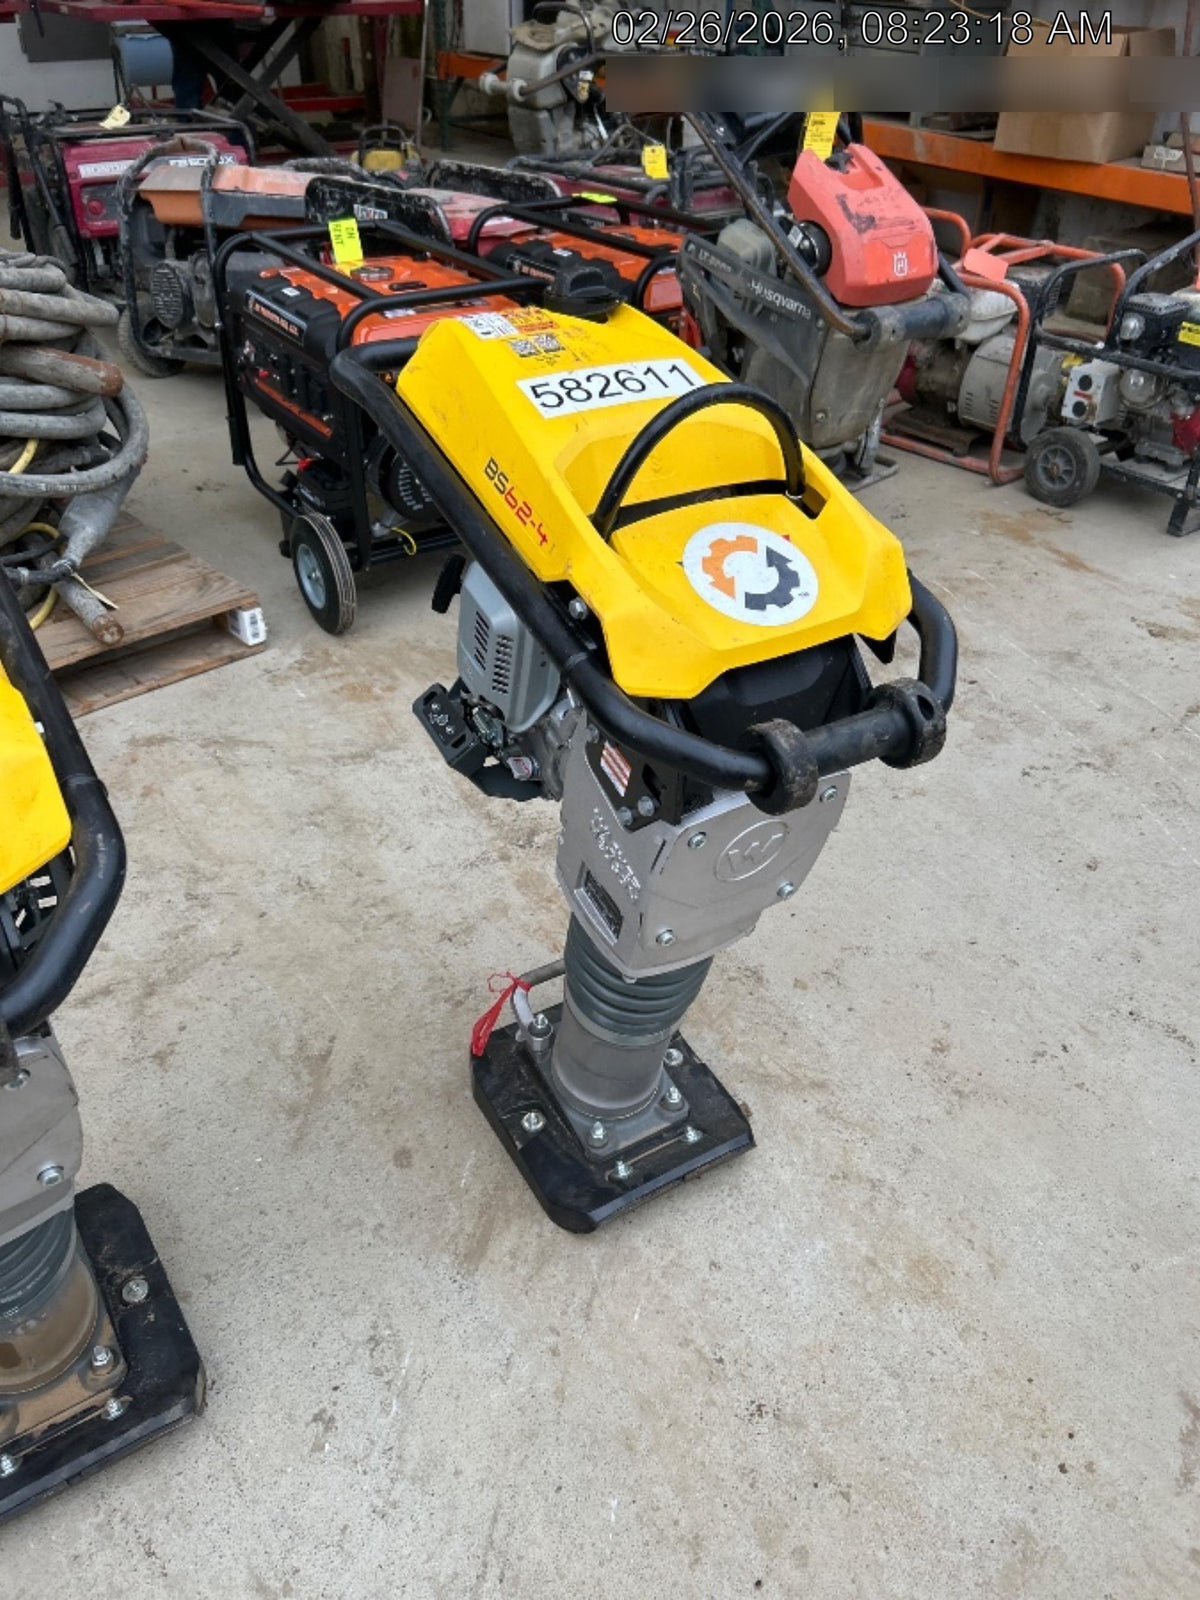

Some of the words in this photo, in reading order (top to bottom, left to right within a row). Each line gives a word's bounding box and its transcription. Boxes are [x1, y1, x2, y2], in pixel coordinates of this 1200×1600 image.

[751, 279, 812, 320] Husqvarna
[529, 363, 696, 409] 582611
[484, 456, 549, 547] BS62-4
